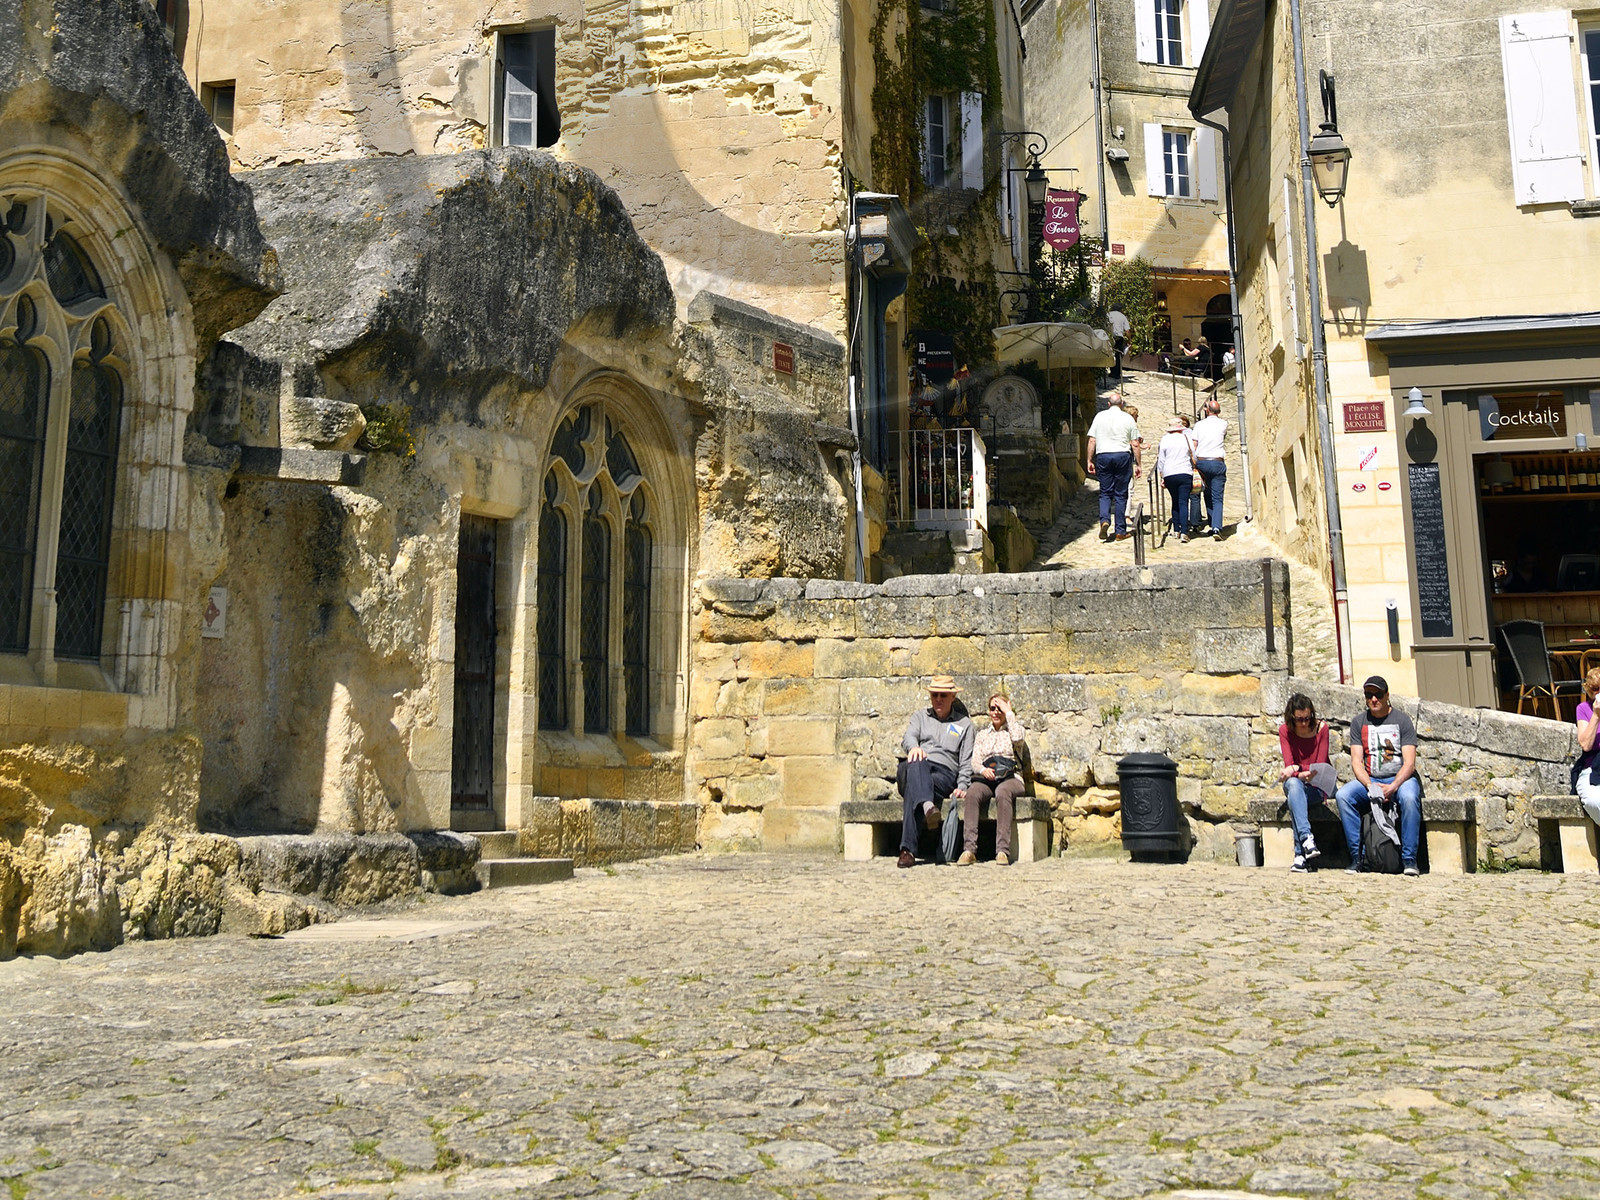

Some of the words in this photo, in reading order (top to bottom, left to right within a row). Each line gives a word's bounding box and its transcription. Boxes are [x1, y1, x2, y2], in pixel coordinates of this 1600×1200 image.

[1047, 195, 1075, 204] Restaurant
[1052, 206, 1069, 219] Le
[1045, 221, 1077, 234] Tertre
[1348, 404, 1369, 412] Place
[1487, 406, 1560, 427] Cocktails
[1345, 419, 1384, 428] MONOLITHE
